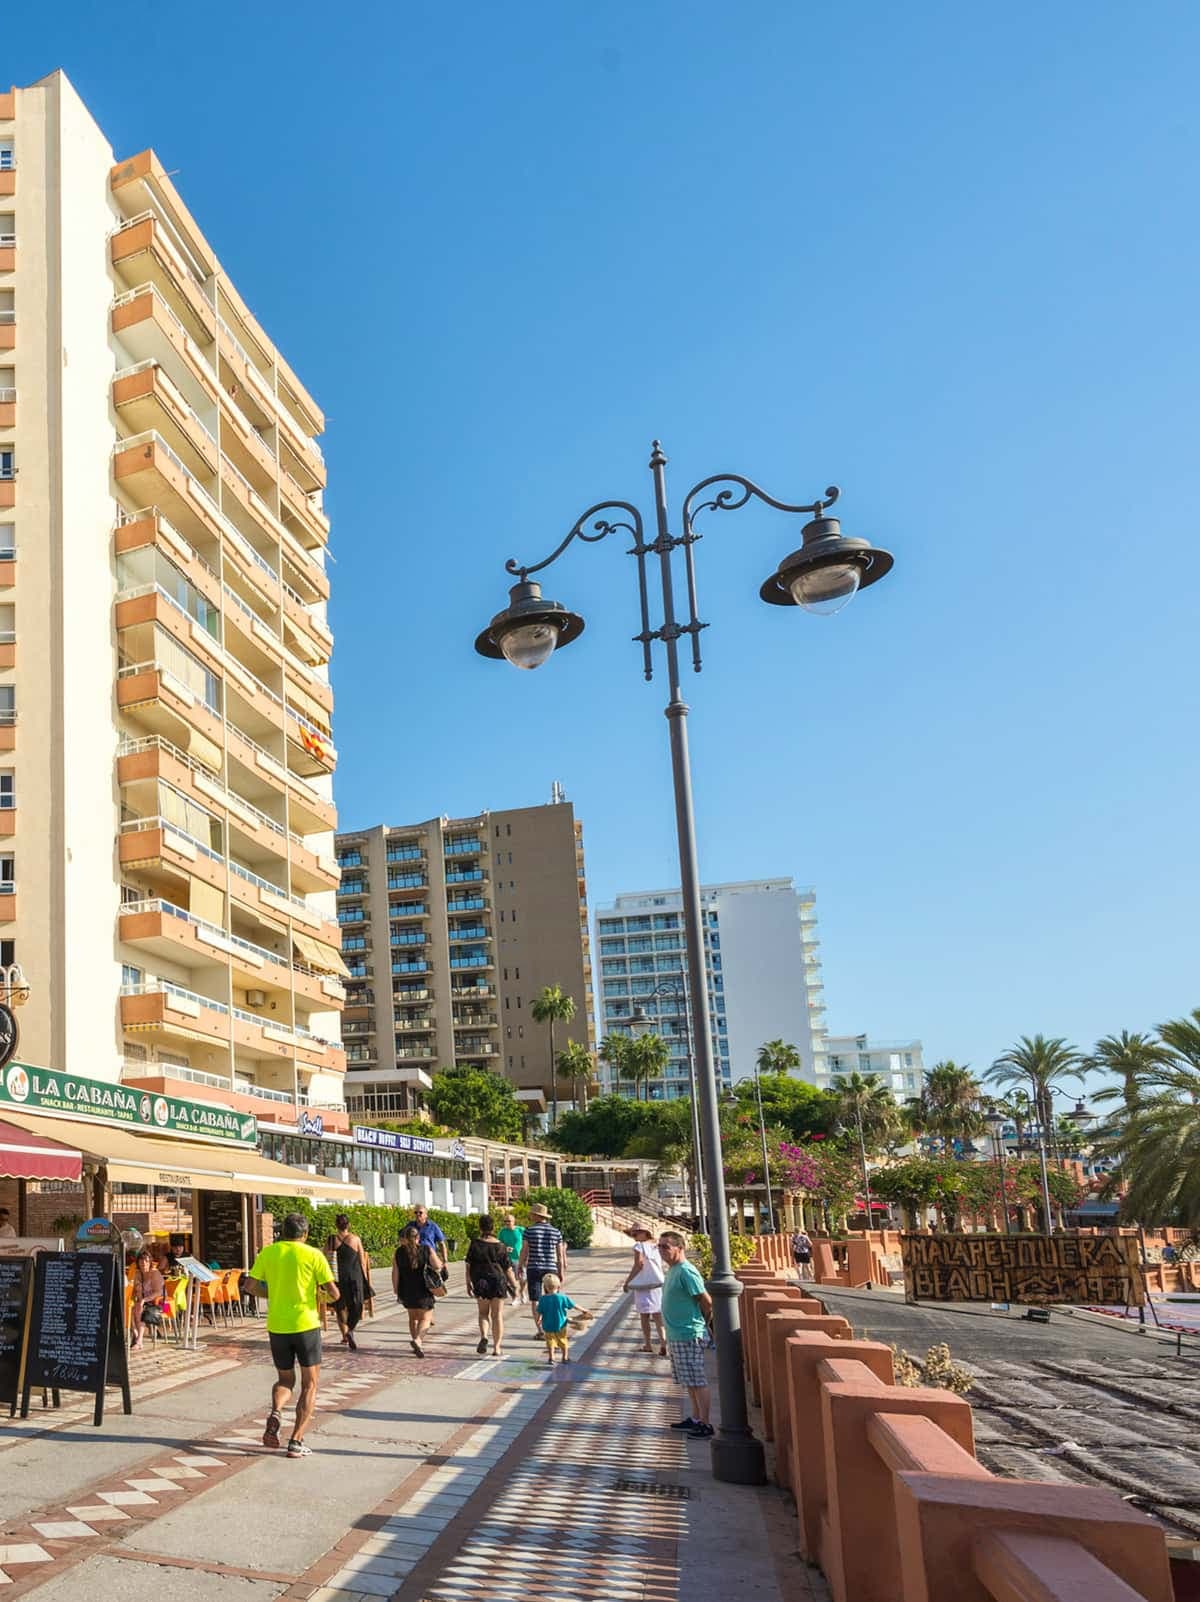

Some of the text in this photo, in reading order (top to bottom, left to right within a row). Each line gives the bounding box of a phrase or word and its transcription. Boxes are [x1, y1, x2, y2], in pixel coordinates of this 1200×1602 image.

[32, 1075, 60, 1097] LA
[64, 1082, 137, 1111] CABAÑA
[40, 1097, 133, 1121] SNACK BAR RESTAURANTE TAPAS
[170, 1104, 189, 1122] LA
[192, 1109, 240, 1131] CABAÑA
[357, 1128, 377, 1144] BEACH
[412, 1138, 433, 1153] SERVICE
[910, 1236, 1125, 1269] MALAPESQUERA
[914, 1267, 1012, 1300] BEACH
